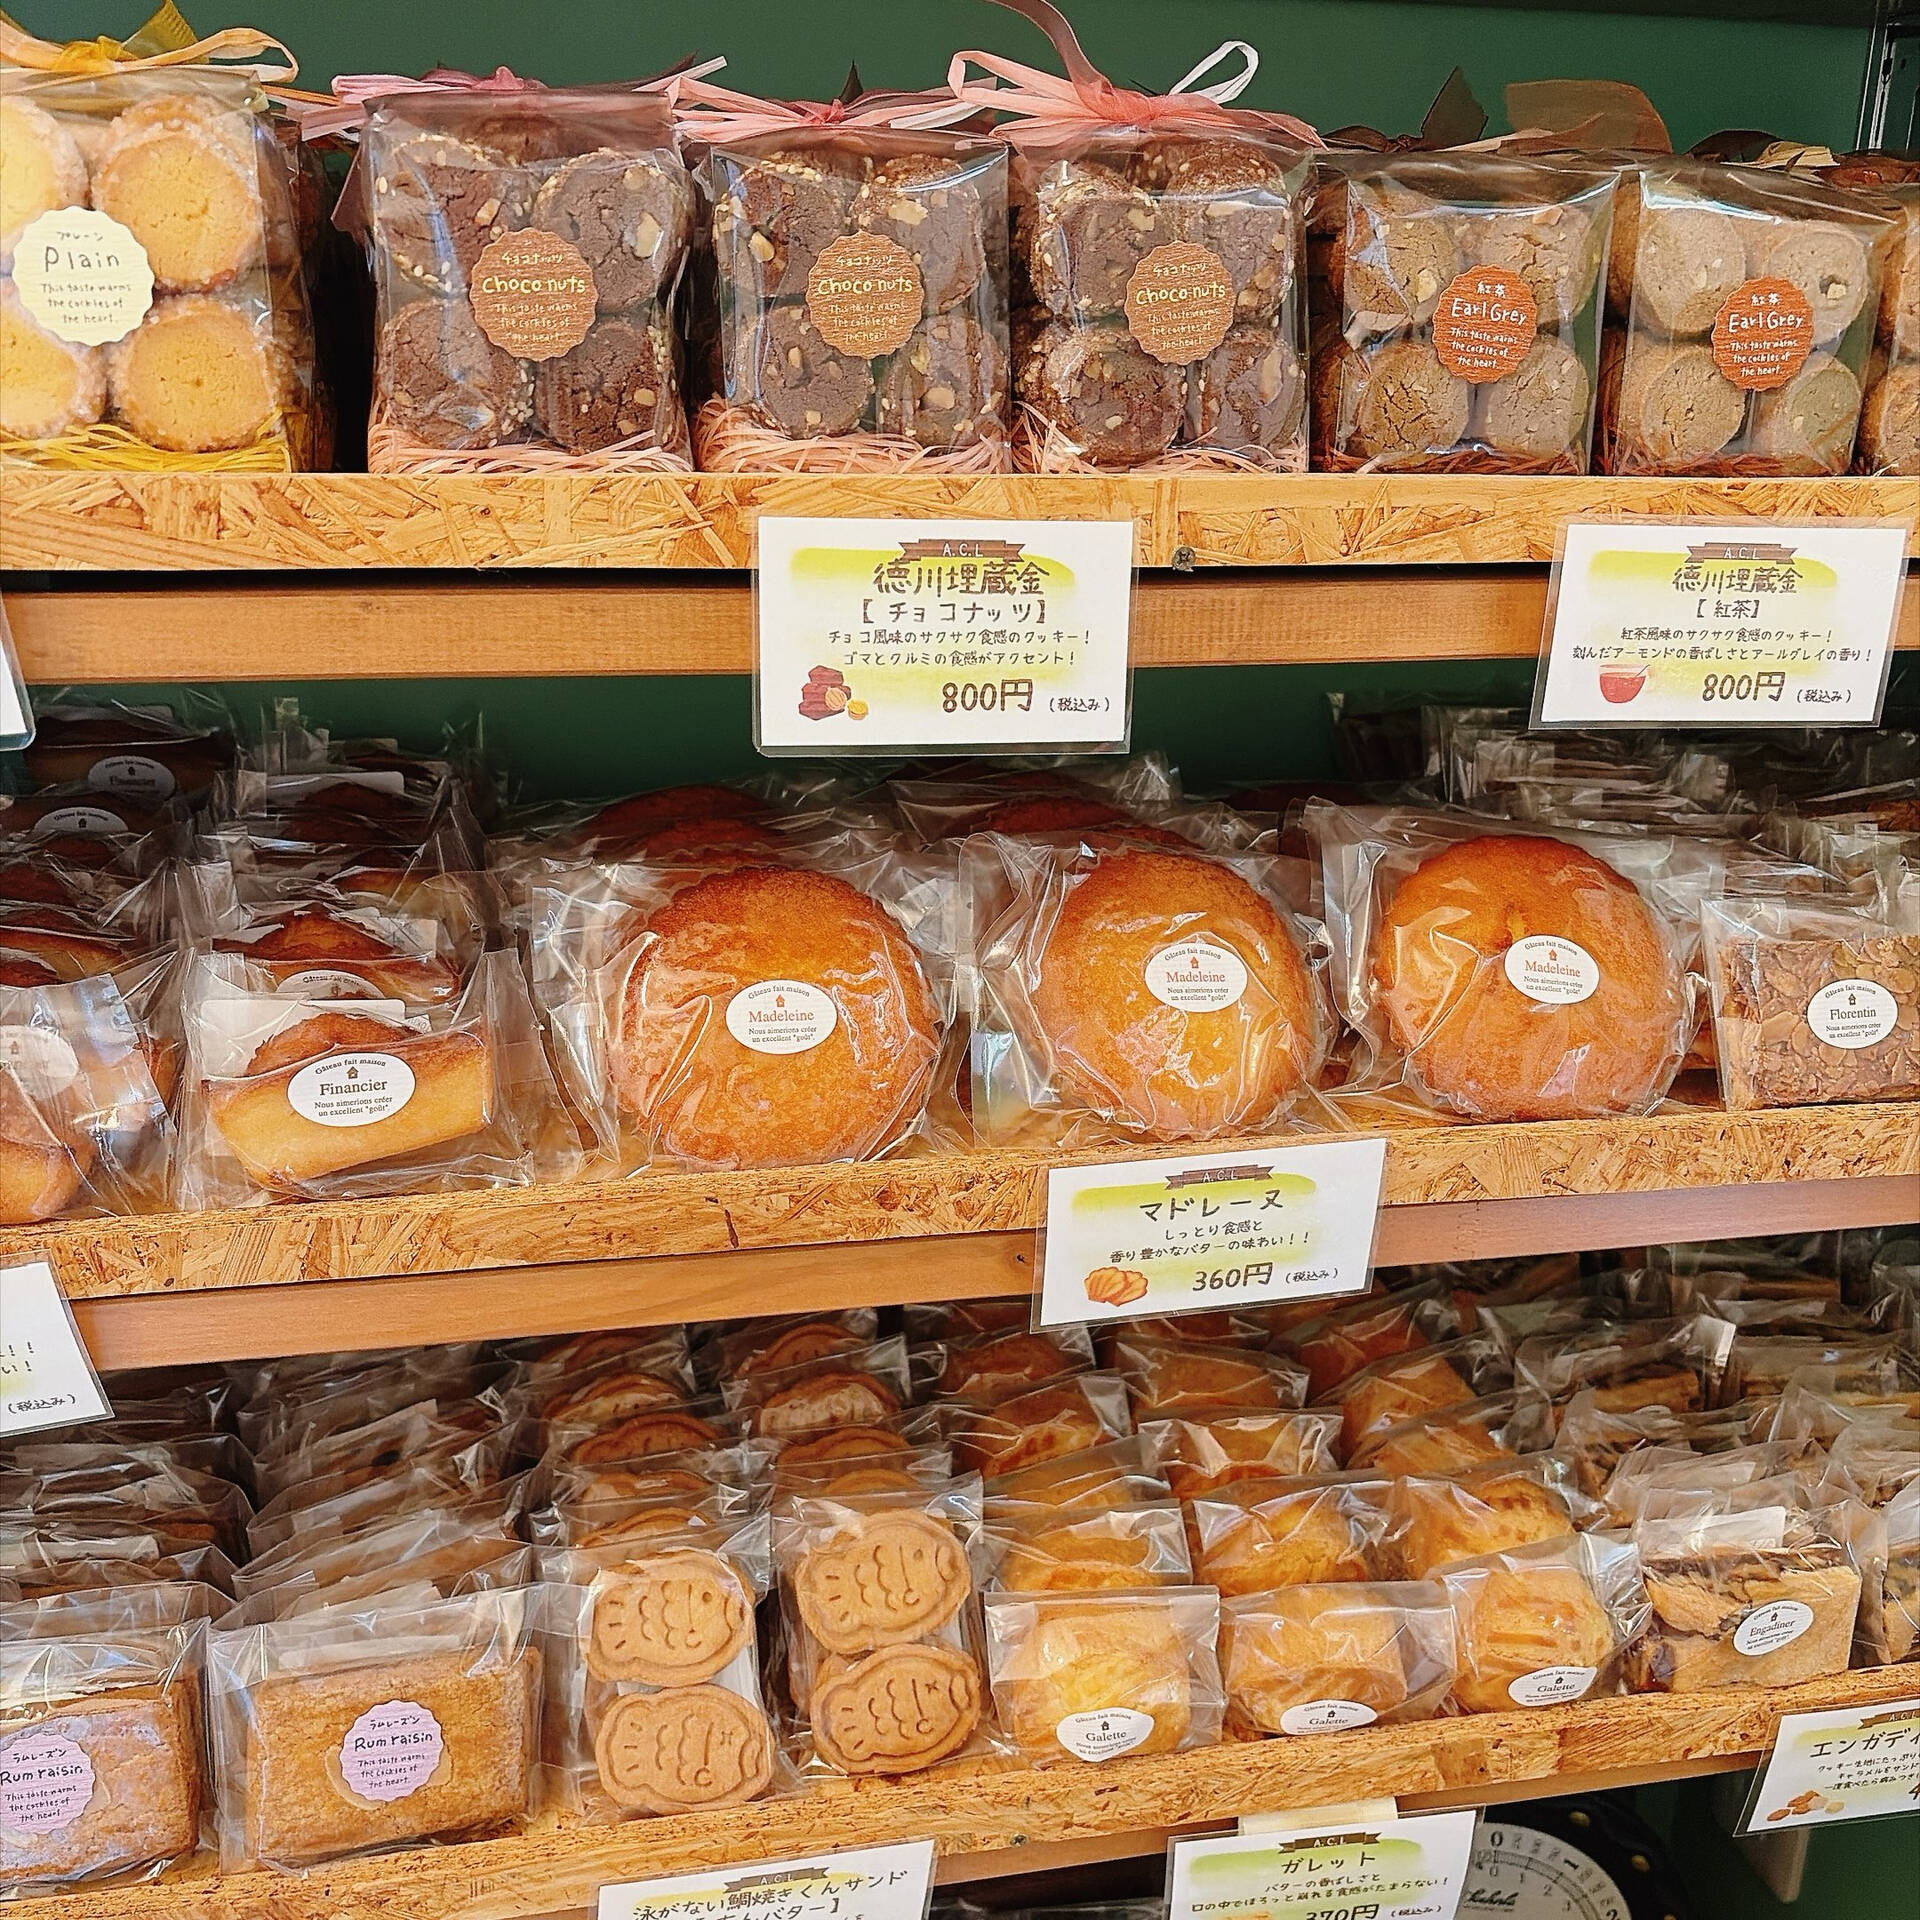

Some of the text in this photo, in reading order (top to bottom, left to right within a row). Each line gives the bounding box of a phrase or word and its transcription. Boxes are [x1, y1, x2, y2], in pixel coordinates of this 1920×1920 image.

[45, 246, 119, 272] Plain
[67, 284, 94, 292] taste
[482, 276, 585, 294] Choco nuts
[818, 276, 913, 294] Choco nuts
[1136, 280, 1226, 305] Choco nuts
[1451, 297, 1527, 326] Earl Grey
[1728, 311, 1804, 333] Earl Grey
[1450, 327, 1468, 338] This
[1470, 330, 1491, 341] taste
[1451, 341, 1465, 351] the
[1499, 348, 1509, 358] of
[1729, 342, 1748, 351] This
[1457, 356, 1471, 366] the
[1733, 355, 1746, 363] the
[1781, 351, 1790, 361] of
[1741, 367, 1755, 377] the
[942, 542, 984, 558] A.C.L
[873, 560, 1050, 598] 徳川埋蔵金
[1671, 564, 1803, 595] 徳川埋蔵金
[1696, 598, 1760, 619] 【紅茶】
[828, 629, 1091, 646] チョコ風味のサクサク食感のクッキー！
[1620, 626, 1832, 643] 紅茶風味のサクサク食感のクッキー！
[844, 651, 1075, 667] ゴマとクルミの食感がアクセント！
[941, 678, 1111, 714] 800円 (税込み)
[1701, 671, 1852, 704] 800円 (税込み)
[1524, 959, 1581, 978] Madeleine
[1166, 971, 1226, 984] Madeleine
[748, 1010, 815, 1023] Madeleine
[1830, 1006, 1877, 1020] Florentin
[315, 1061, 342, 1075] Gâteau
[360, 1059, 387, 1068] maison
[320, 1080, 388, 1096] Financier
[314, 1101, 334, 1109] Nous
[1139, 1189, 1284, 1222] マドレーヌ
[1165, 1219, 1263, 1241] しっとり食感と
[1110, 1231, 1310, 1264] 香り豊かなバターの味わい！！
[1192, 1262, 1338, 1292] 360円 (税込み)
[8, 1394, 76, 1414] (税込み)
[1750, 1620, 1796, 1637] Engadiner
[369, 1715, 420, 1730] ラムレーズン
[354, 1732, 433, 1752] Rum raisin
[1085, 1731, 1127, 1742] Galette
[12, 1748, 67, 1764] ラムレーズン
[1819, 1752, 1920, 1773] クッキー生地にたっぷり
[0, 1765, 83, 1786] Rum raisin
[1490, 1831, 1503, 1847] 0
[1281, 1852, 1375, 1874] ガレット
[633, 1870, 908, 1920] 泳がない鯛焼きくんサンド
